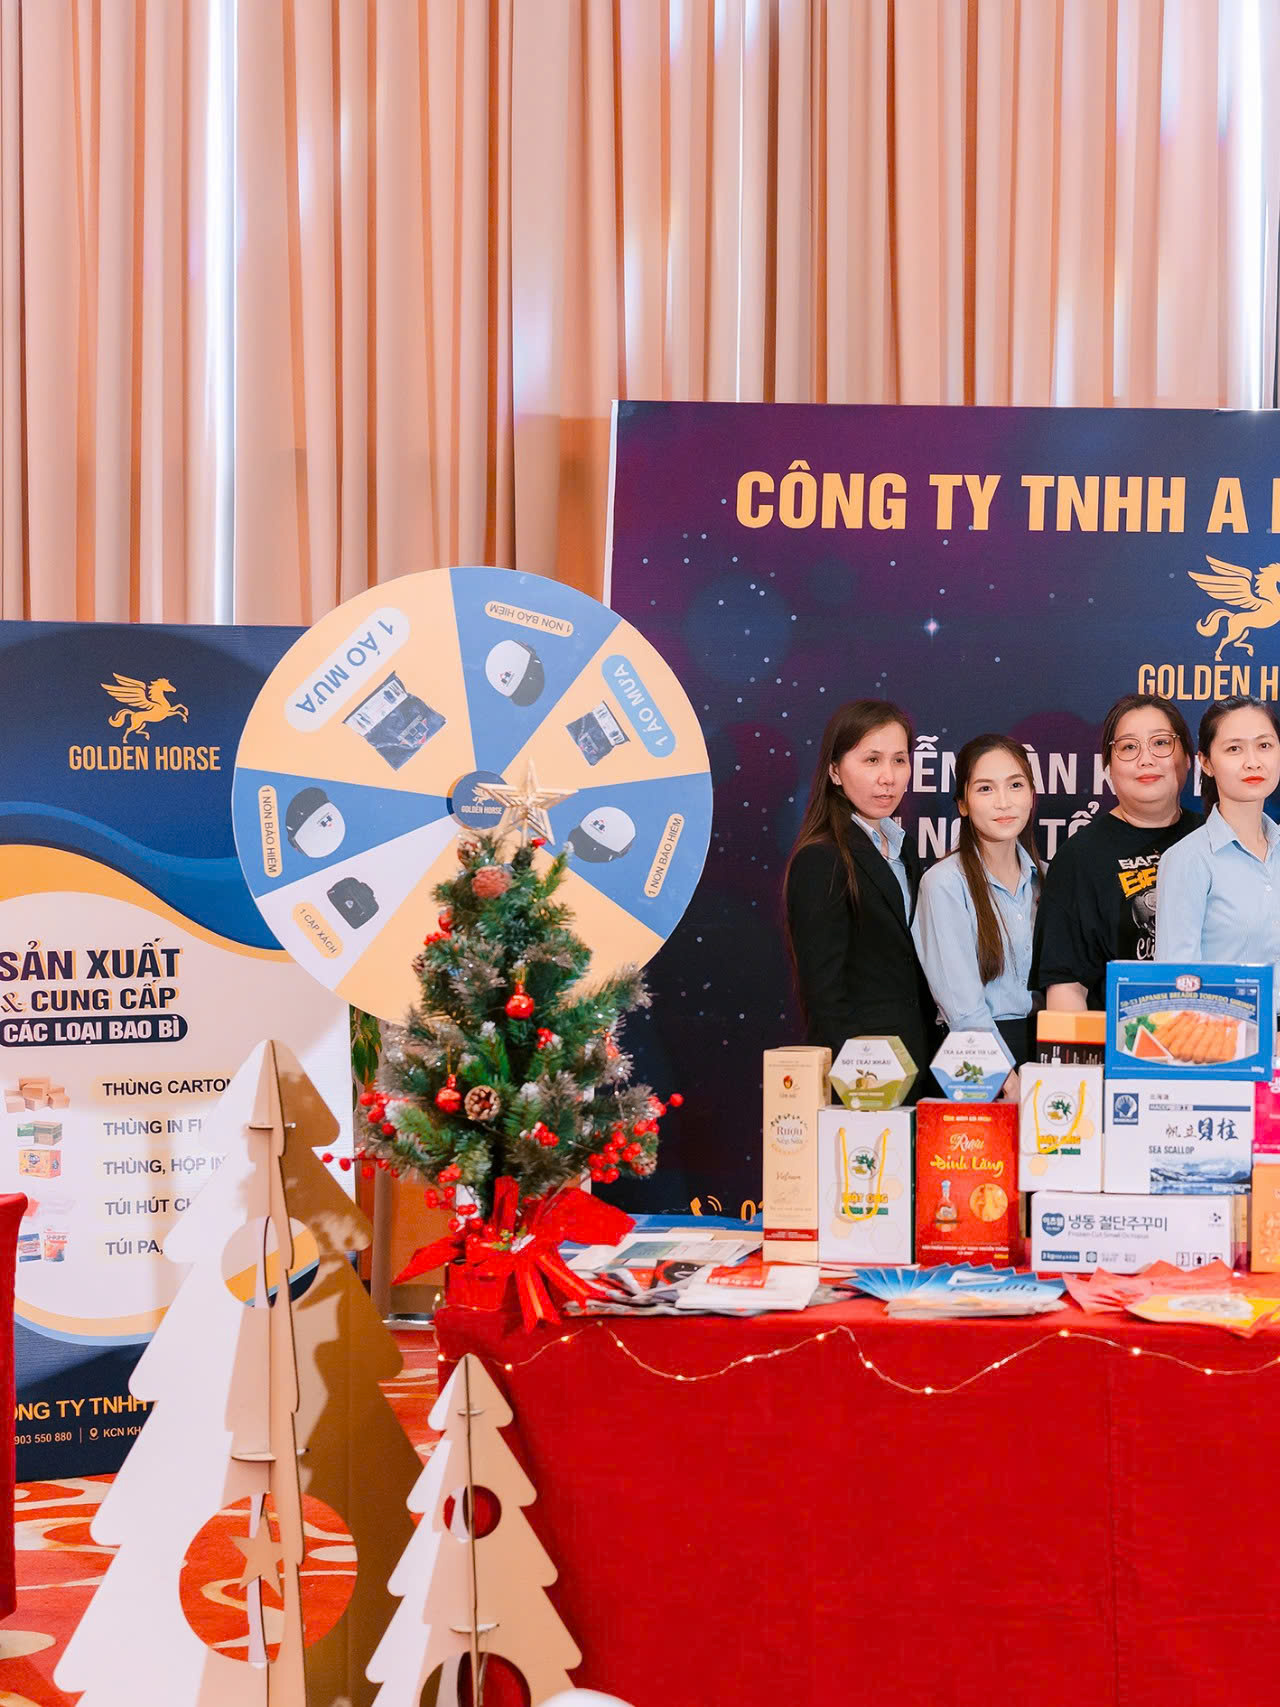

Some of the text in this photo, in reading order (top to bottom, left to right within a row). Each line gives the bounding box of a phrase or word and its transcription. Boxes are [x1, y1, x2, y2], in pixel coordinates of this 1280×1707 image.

[736, 459, 907, 530] CÔNG
[929, 473, 1001, 531] TY
[1021, 475, 1186, 533] TNHH
[1206, 477, 1249, 533] A
[295, 620, 393, 713] 1 ÁO MƯA
[1138, 663, 1250, 700] GOLDEN
[68, 744, 222, 772] GOLDEN HORSE
[1023, 744, 1078, 795] ÀN
[0, 938, 181, 981] SẢN XUẤT
[31, 988, 110, 1012] CUNG
[120, 980, 177, 1010] CẤP
[3, 1016, 180, 1044] CÁC LOẠI BAO BÌ
[102, 1078, 162, 1096] THÙNG
[103, 1118, 162, 1136] THÙNG
[167, 1119, 183, 1133] IN
[1148, 1145, 1195, 1155] SEA SCALLOP
[103, 1157, 166, 1175] THÙNG,
[171, 1155, 206, 1175] HỘP
[105, 1197, 131, 1216] TÚI
[136, 1196, 170, 1214] HÚT
[1068, 1215, 1168, 1231] 냉동 절단주꾸미
[105, 1237, 132, 1255] TÚI
[56, 1398, 86, 1418] TY
[88, 1394, 147, 1416] TNHH
[34, 1433, 52, 1443] 550
[54, 1431, 73, 1441] 880
[103, 1427, 125, 1438] KCN
